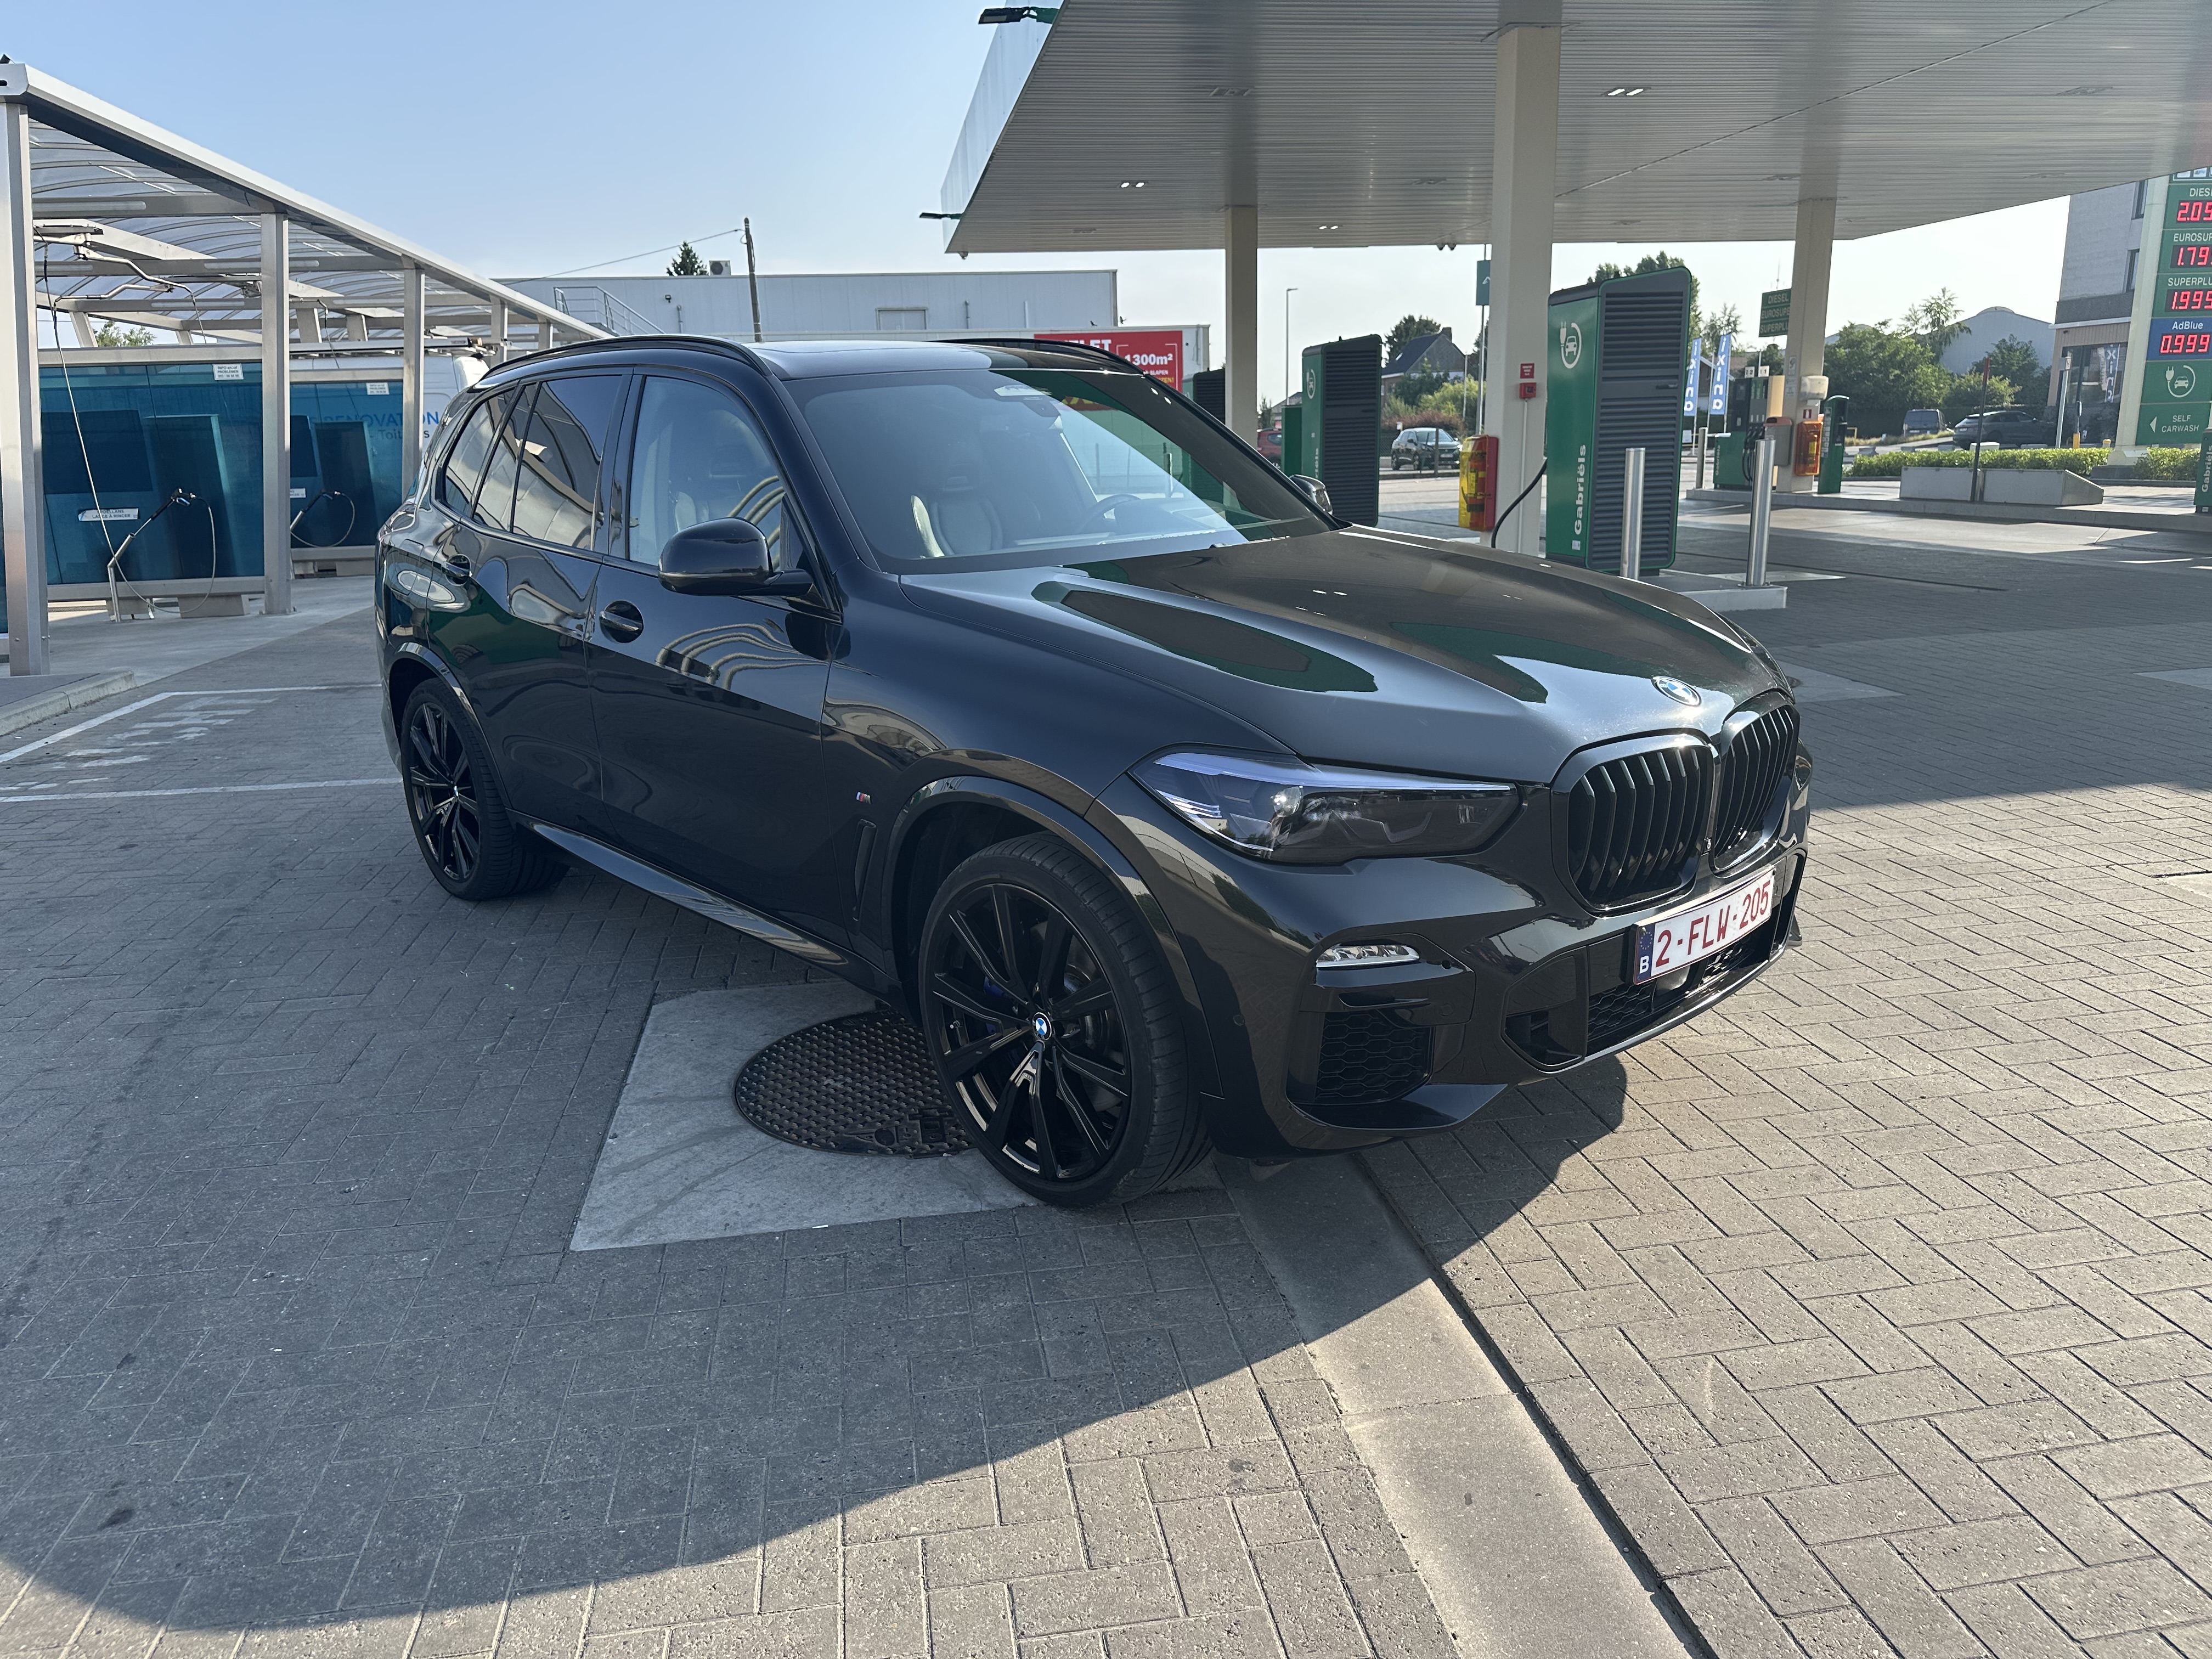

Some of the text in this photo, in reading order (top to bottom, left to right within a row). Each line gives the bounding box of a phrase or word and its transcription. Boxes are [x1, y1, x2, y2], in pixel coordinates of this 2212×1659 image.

[2189, 188, 2212, 197] DIES
[2177, 246, 2212, 266] 1.79
[1768, 293, 1788, 304] DIESEL
[2171, 321, 2203, 330] AdBlue
[2160, 334, 2210, 353] 0.999
[1712, 337, 1726, 410] ixina
[2162, 425, 2199, 433] CARWASH
[1575, 445, 1587, 535] Gabriëls
[1656, 880, 1770, 968] 2-FLW-205
[1639, 955, 1650, 974] B
